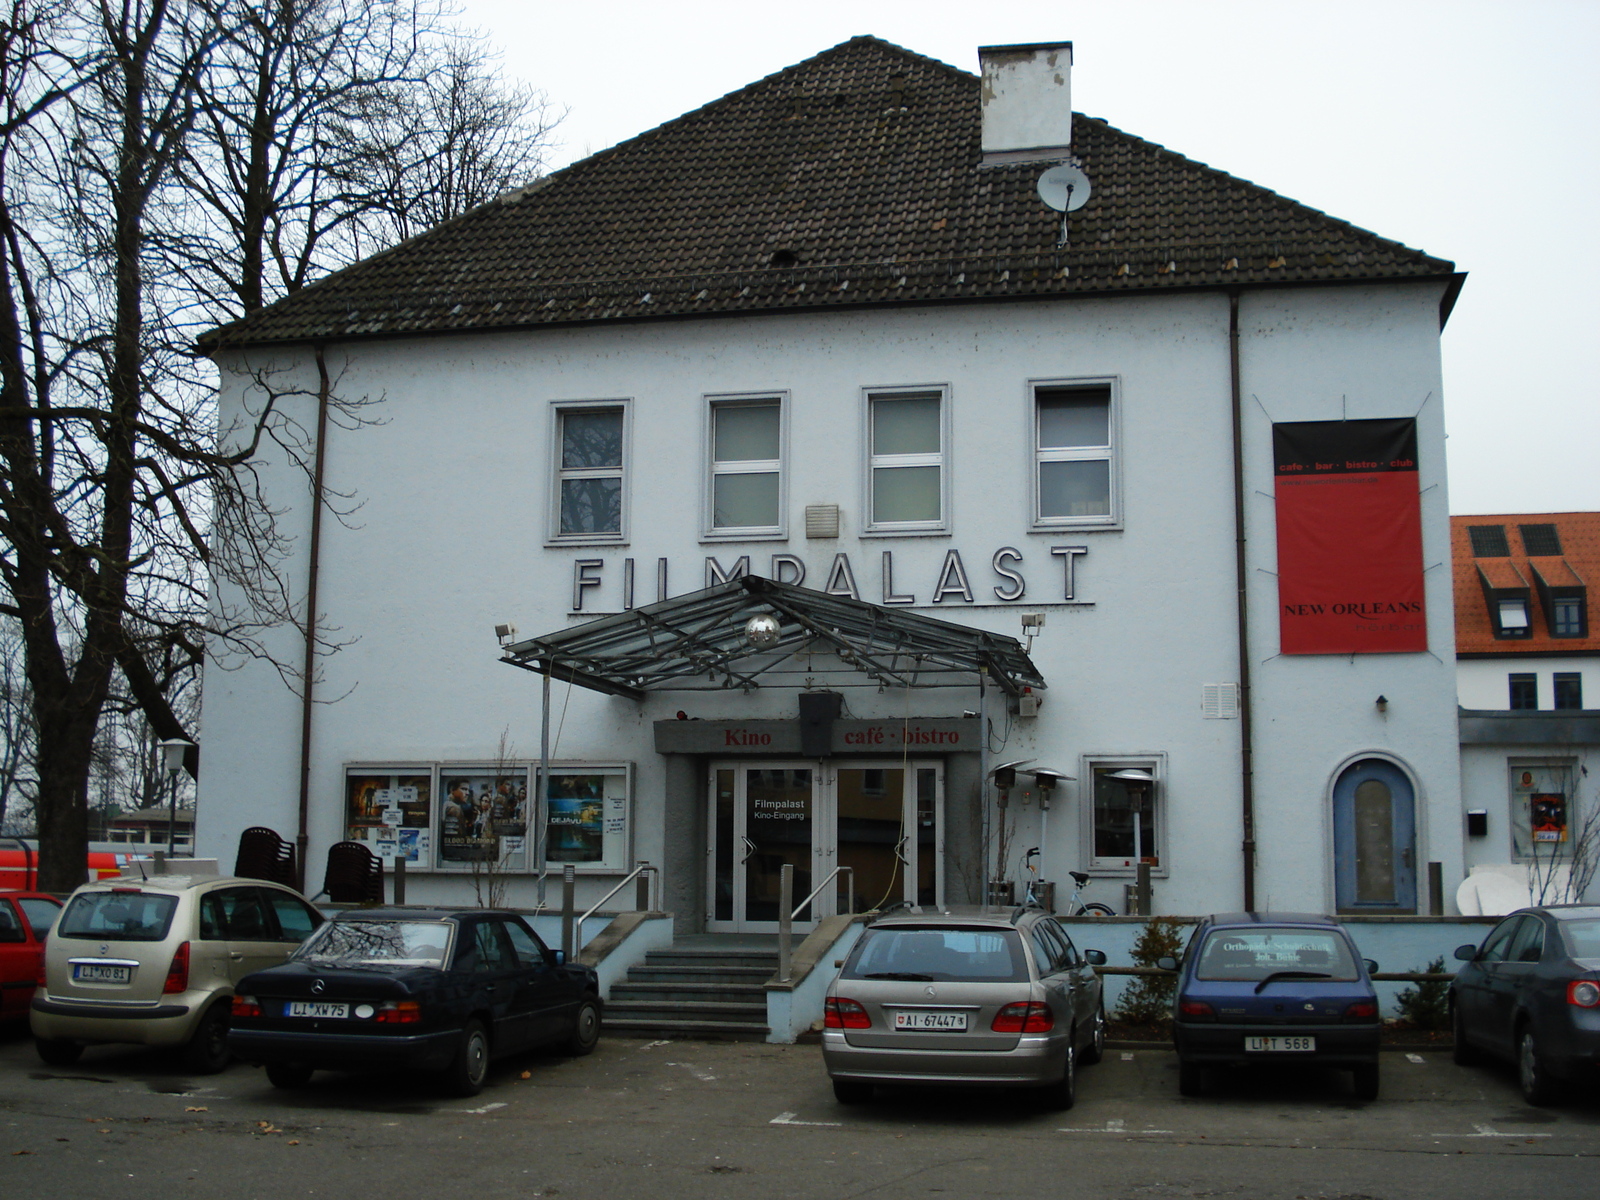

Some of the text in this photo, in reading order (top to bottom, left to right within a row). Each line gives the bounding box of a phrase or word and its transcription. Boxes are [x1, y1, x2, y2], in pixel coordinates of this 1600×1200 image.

[1279, 458, 1414, 472] cafe bar bistro club
[573, 546, 1088, 610] FILMPALAST
[1284, 601, 1422, 620] NEW ORLEANS
[724, 729, 772, 746] Kino
[844, 727, 960, 745] café bistro
[754, 799, 805, 810] Filmpalast
[754, 811, 805, 821] Kino-Eingang
[1284, 1038, 1310, 1050] 568
